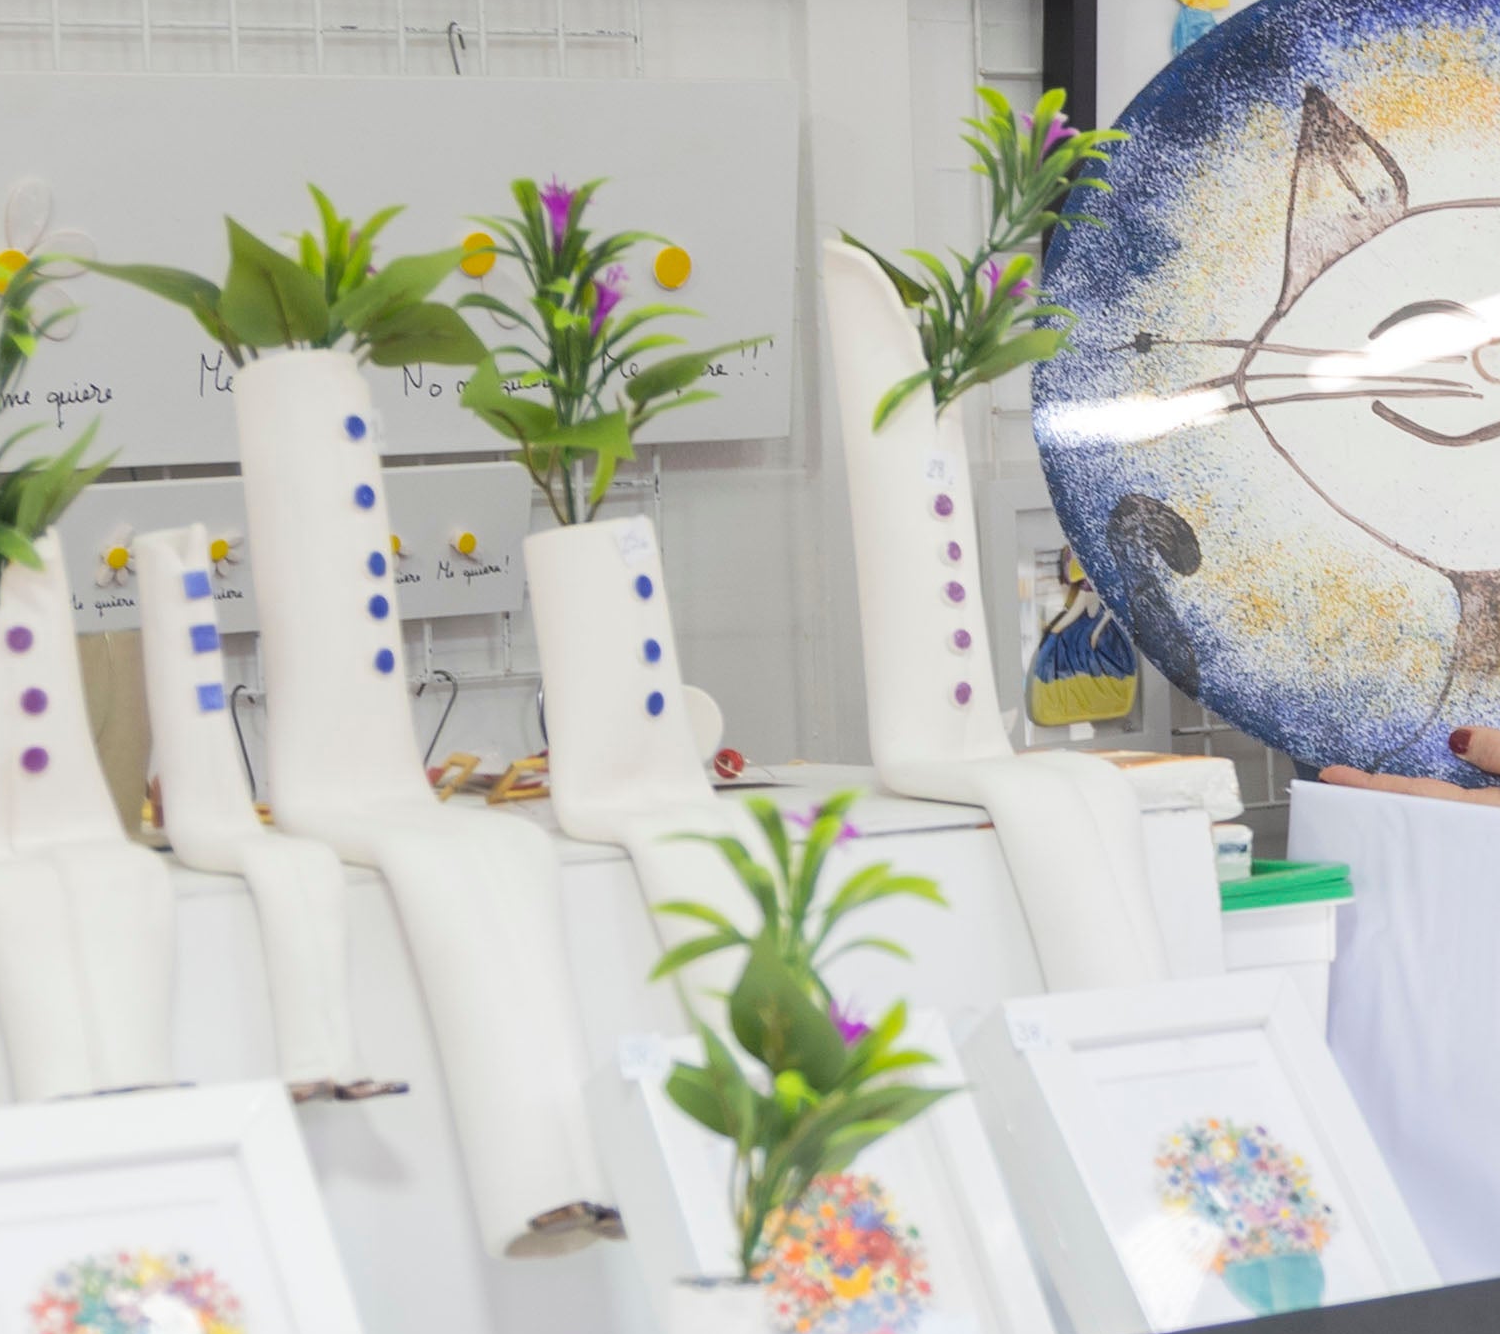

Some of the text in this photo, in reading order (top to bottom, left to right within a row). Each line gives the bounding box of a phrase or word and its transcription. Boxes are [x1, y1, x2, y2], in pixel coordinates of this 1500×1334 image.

[0, 389, 30, 408] me
[47, 382, 113, 429] quiere
[200, 350, 234, 397] Me
[403, 363, 442, 397] No
[95, 597, 136, 617] quiere
[437, 561, 455, 580] Me
